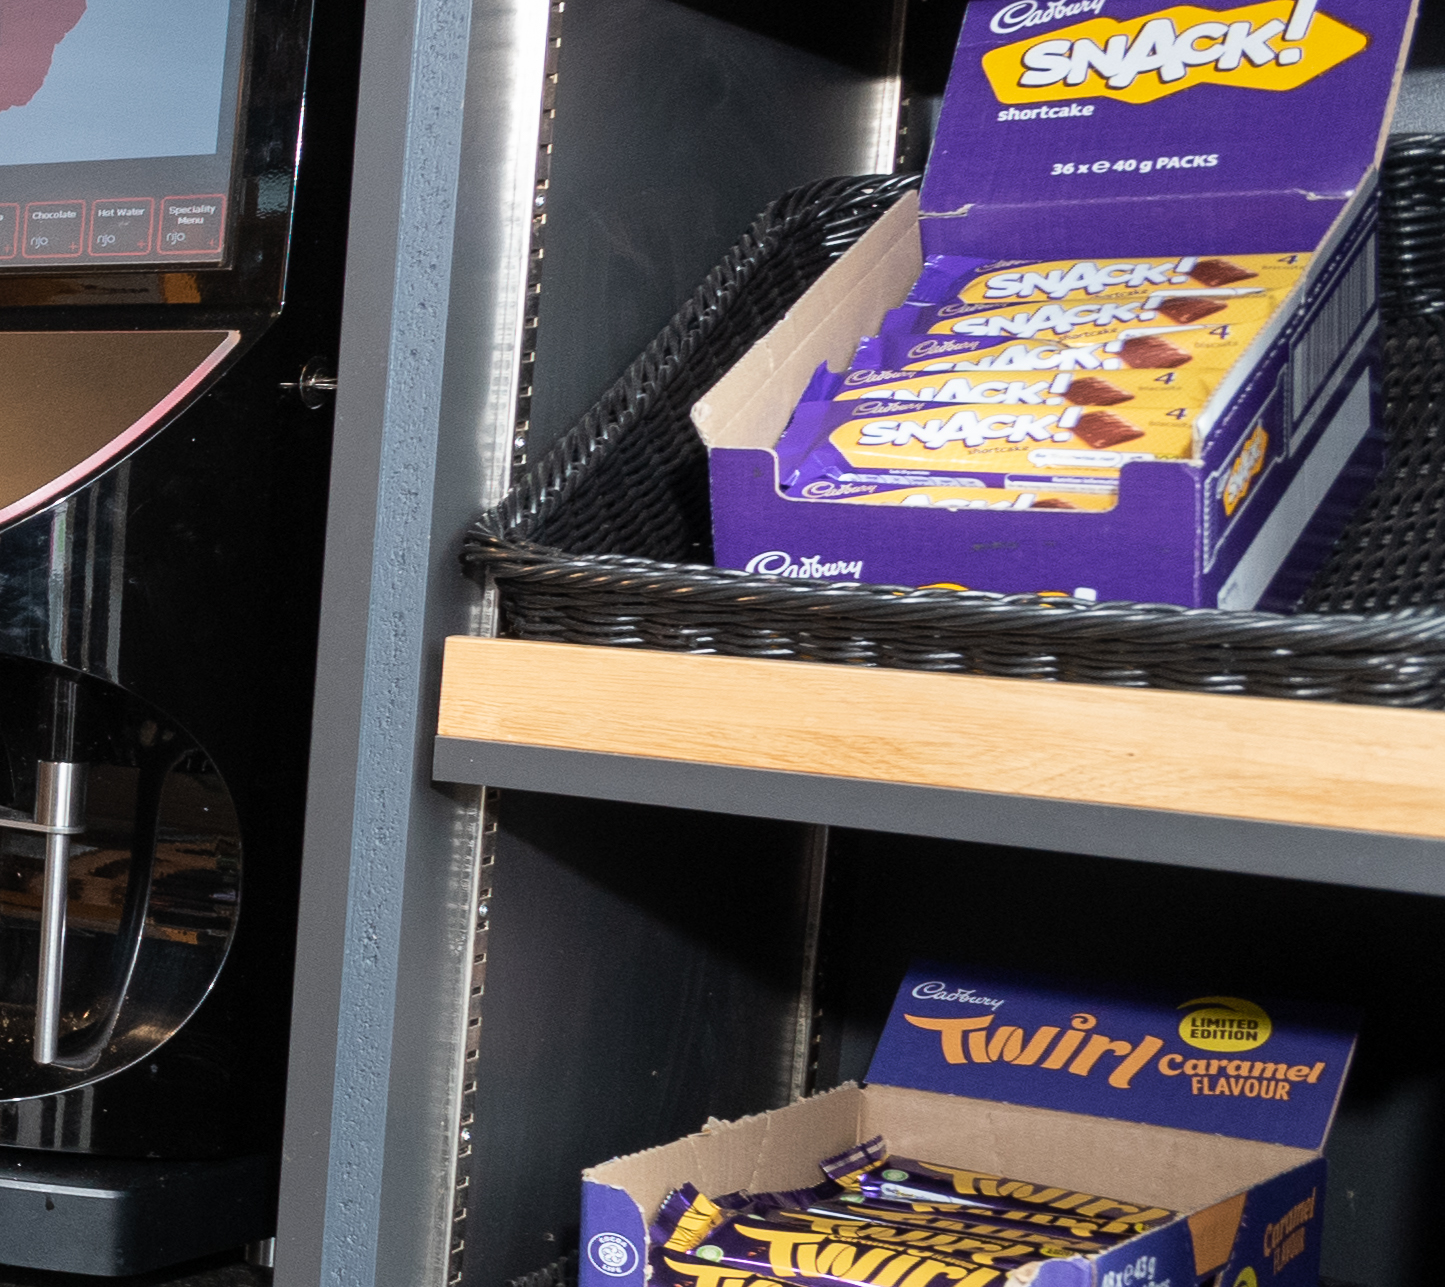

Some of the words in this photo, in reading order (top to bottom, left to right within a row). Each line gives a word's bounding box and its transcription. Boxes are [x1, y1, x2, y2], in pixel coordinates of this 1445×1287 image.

[997, 102, 1095, 121] shortcake
[1051, 161, 1075, 175] 36
[1113, 157, 1137, 173] 40
[1155, 154, 1219, 171] PACKS
[31, 209, 77, 222] Chocolate
[97, 208, 114, 218] Hot
[115, 206, 147, 218] Water
[168, 204, 217, 218] Speciality
[177, 215, 205, 227] Menu
[858, 408, 1084, 449] SNACK!
[911, 980, 1005, 1012] Cadbury
[1190, 1015, 1259, 1031] LIMITED
[1190, 1027, 1258, 1042] EDITION
[903, 1011, 1165, 1090] Twirl
[1157, 1053, 1327, 1085] Caramel
[1190, 1077, 1291, 1101] FLAVOUR
